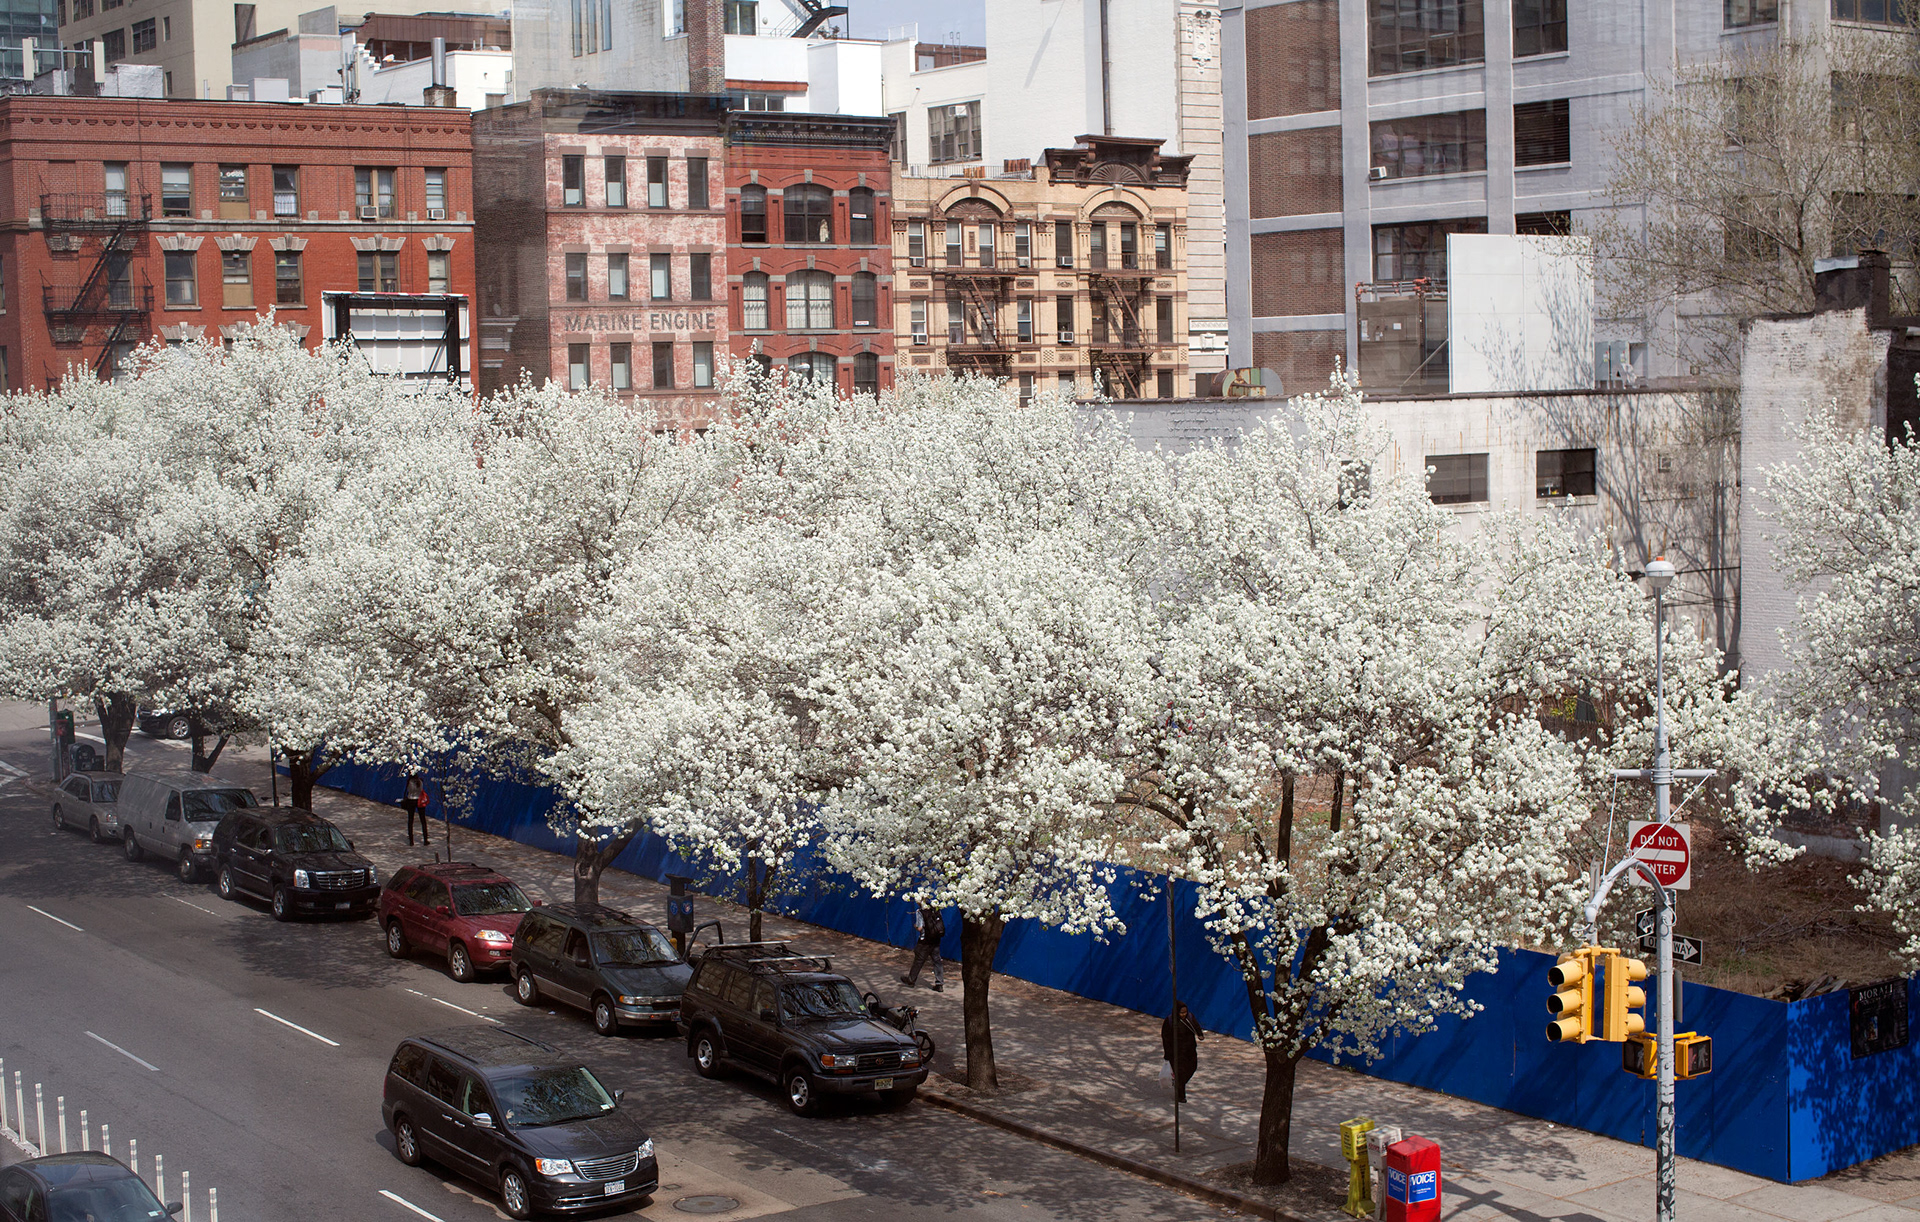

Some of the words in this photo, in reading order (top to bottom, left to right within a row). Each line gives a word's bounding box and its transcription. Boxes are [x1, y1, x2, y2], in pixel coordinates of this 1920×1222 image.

[565, 313, 642, 331] MARINE
[651, 313, 716, 330] ENGINE
[1640, 834, 1654, 845] DO
[1658, 836, 1678, 847] NOT
[1645, 862, 1677, 875] NTER
[1673, 942, 1692, 955] WAY
[1388, 1168, 1406, 1185] VOICE
[1411, 1172, 1435, 1186] VOICE
